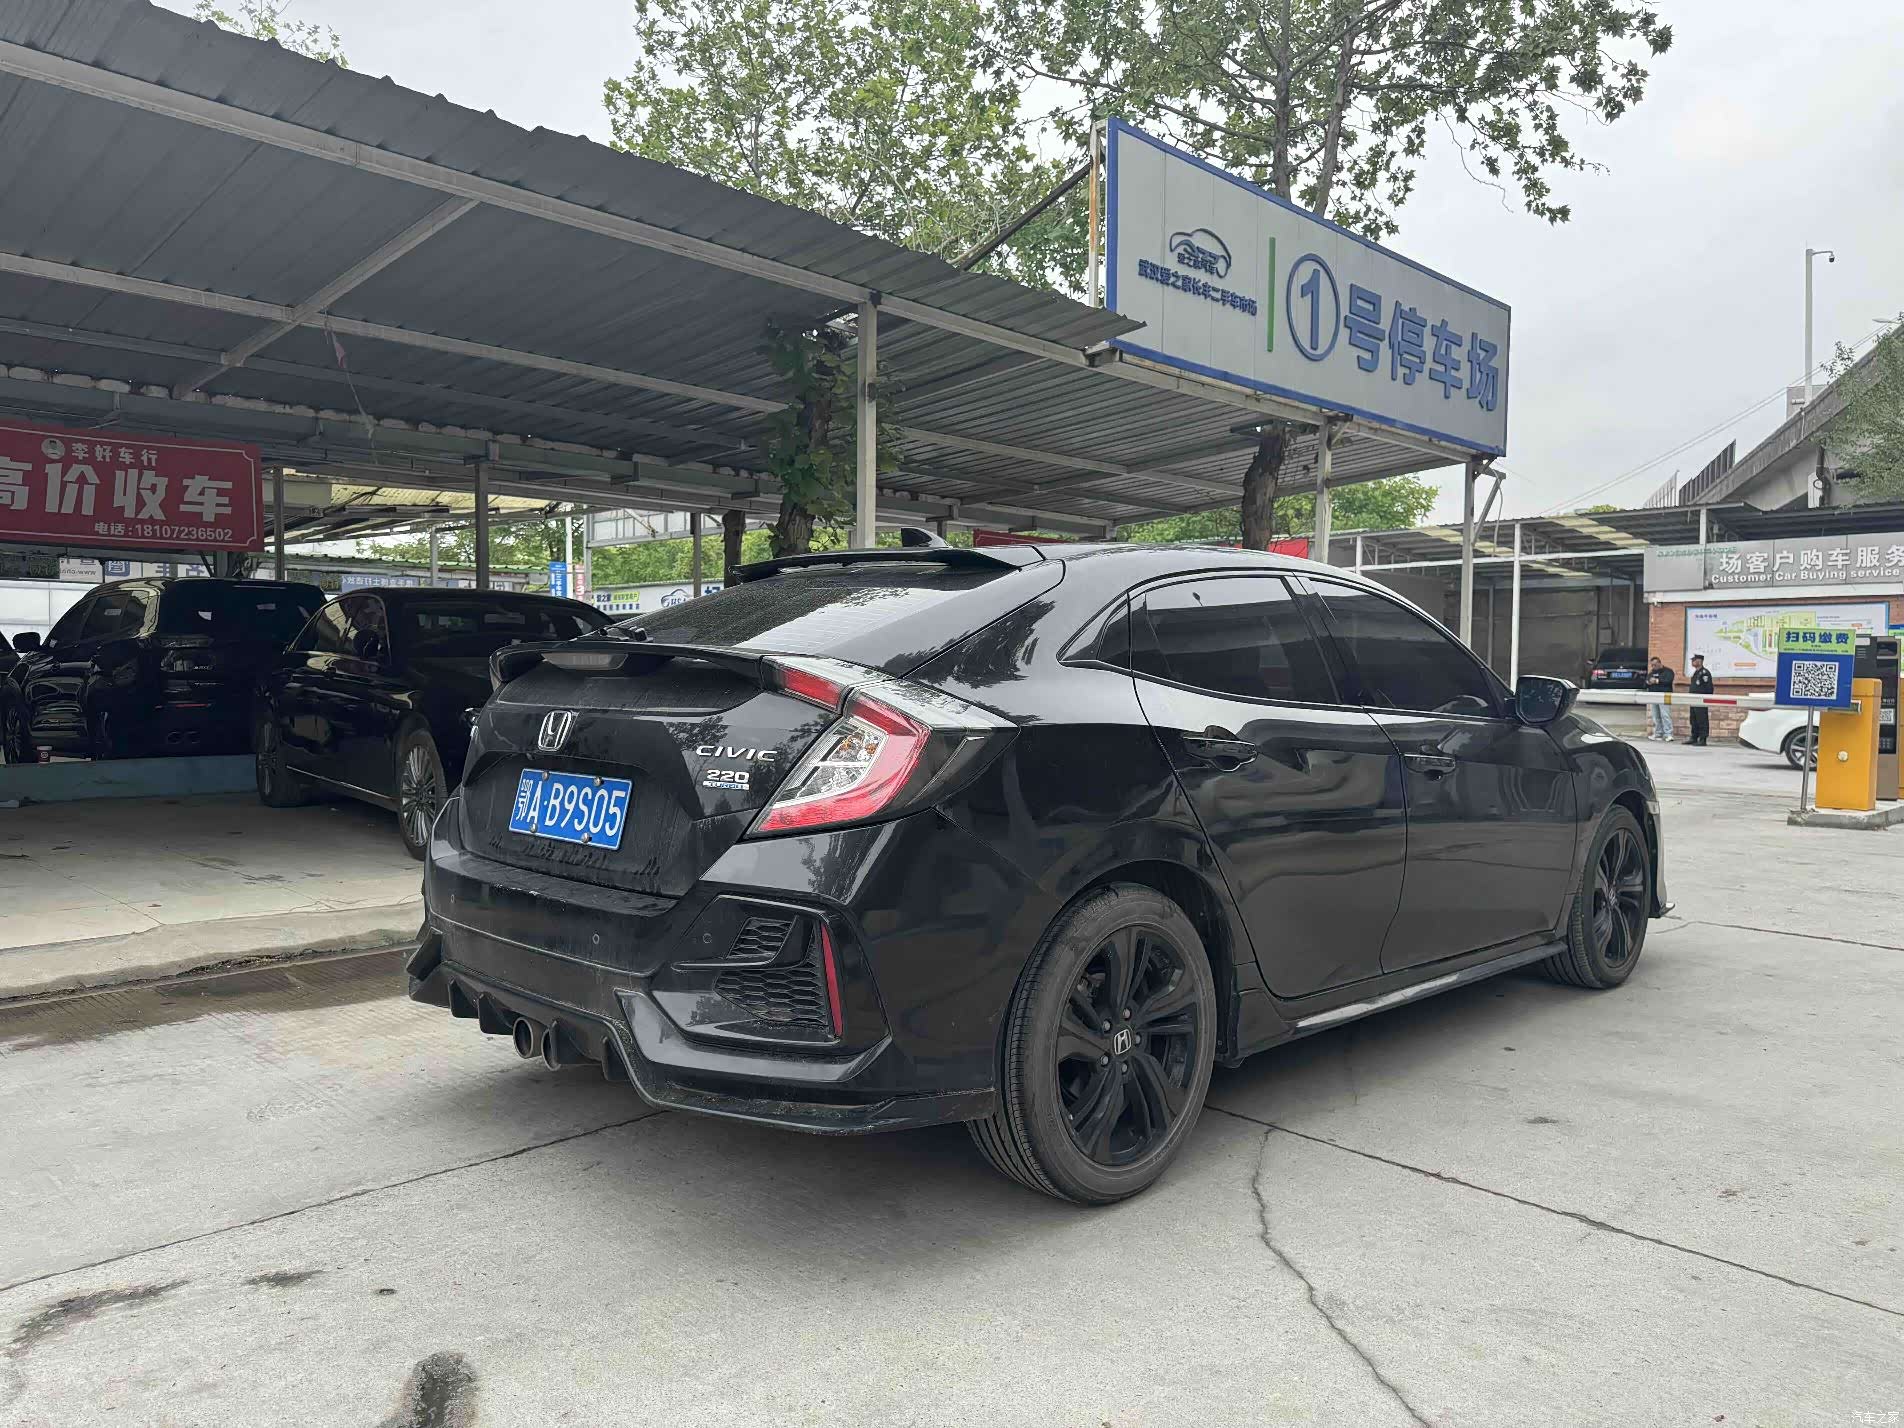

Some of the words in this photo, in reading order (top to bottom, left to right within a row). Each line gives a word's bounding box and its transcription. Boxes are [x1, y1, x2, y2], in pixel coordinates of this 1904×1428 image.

[71, 442, 158, 466] 李好车行
[0, 456, 233, 523] 高价收车
[1719, 546, 1904, 574] 场客户购车服务
[1711, 573, 1772, 584] Customer
[1775, 571, 1797, 581] Car
[1800, 568, 1847, 581] Buying
[1784, 631, 1850, 645] 扫码缴费
[695, 745, 778, 762] CIVIC
[706, 769, 749, 784] 220
